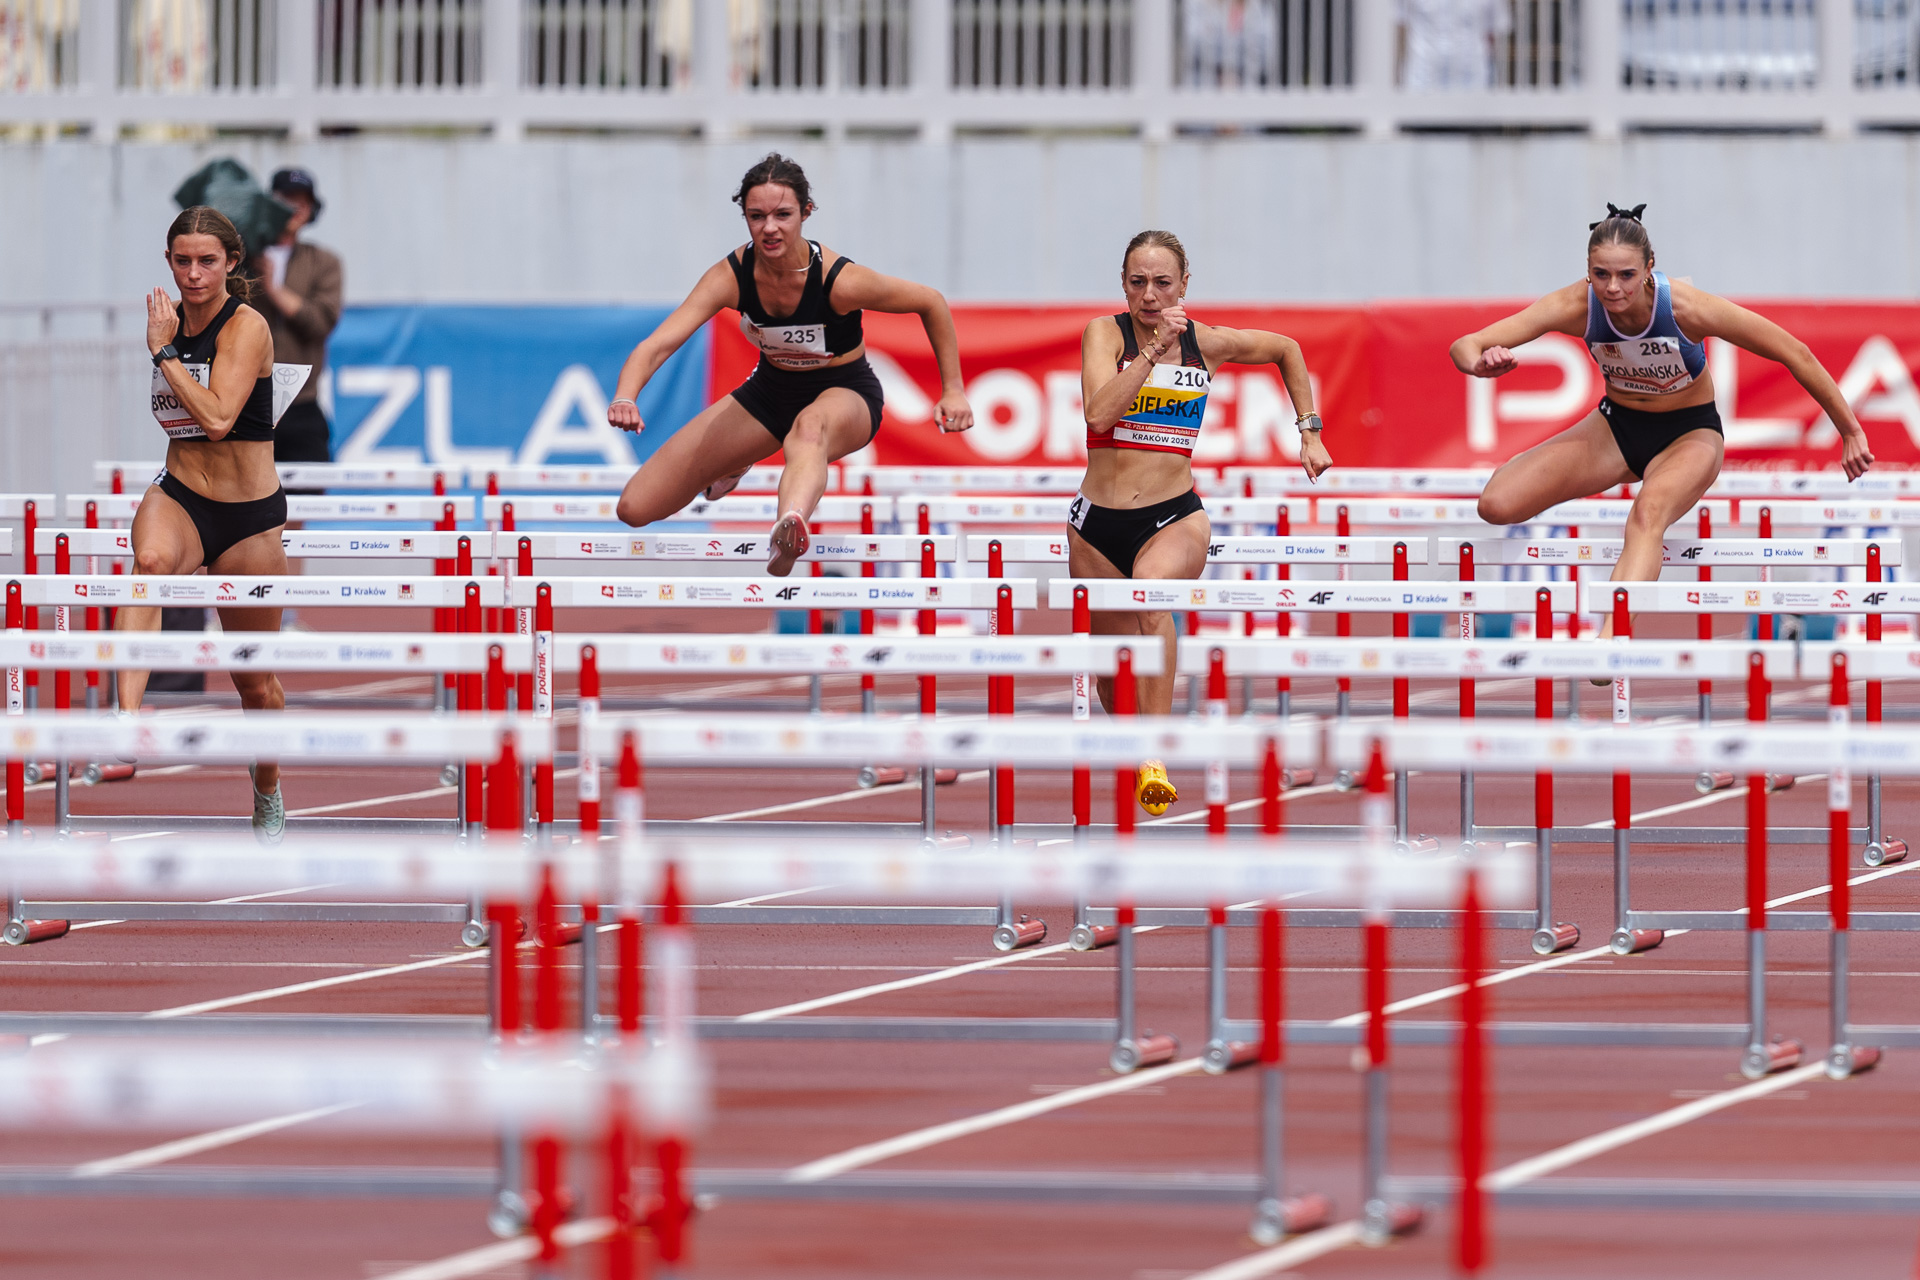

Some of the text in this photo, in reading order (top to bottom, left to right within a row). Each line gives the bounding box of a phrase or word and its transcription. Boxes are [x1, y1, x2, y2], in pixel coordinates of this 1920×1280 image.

[783, 330, 816, 344] 235
[1640, 342, 1672, 356] 281
[185, 368, 201, 383] 75
[1602, 363, 1683, 379] SKOLASIŃSKA
[1174, 370, 1204, 387] 210
[1467, 332, 1920, 451] PLA
[1624, 381, 1658, 392] KRAKÓW
[152, 394, 184, 411] BRO
[963, 368, 1321, 462] OREN
[1132, 433, 1190, 445] KRAKÓW 2025
[1070, 498, 1084, 523] 4
[361, 542, 390, 550] Kraków
[733, 542, 756, 555] 4F
[827, 546, 856, 554] Kraków
[1296, 547, 1325, 555] Kraków
[1680, 547, 1703, 559] 4F
[1775, 549, 1803, 557] Kraków
[248, 584, 273, 599] 4F
[354, 587, 387, 596] Kraków
[775, 586, 801, 600] 4F
[882, 589, 914, 598] Kraków
[1308, 591, 1334, 605] 4F
[1415, 594, 1448, 603] Kraków
[1862, 592, 1888, 605] 4F
[57, 605, 67, 632] polan
[518, 607, 529, 636] polan
[989, 609, 998, 638] polan
[1461, 612, 1470, 640] polan
[9, 665, 20, 693] pola
[537, 651, 549, 696] polanik
